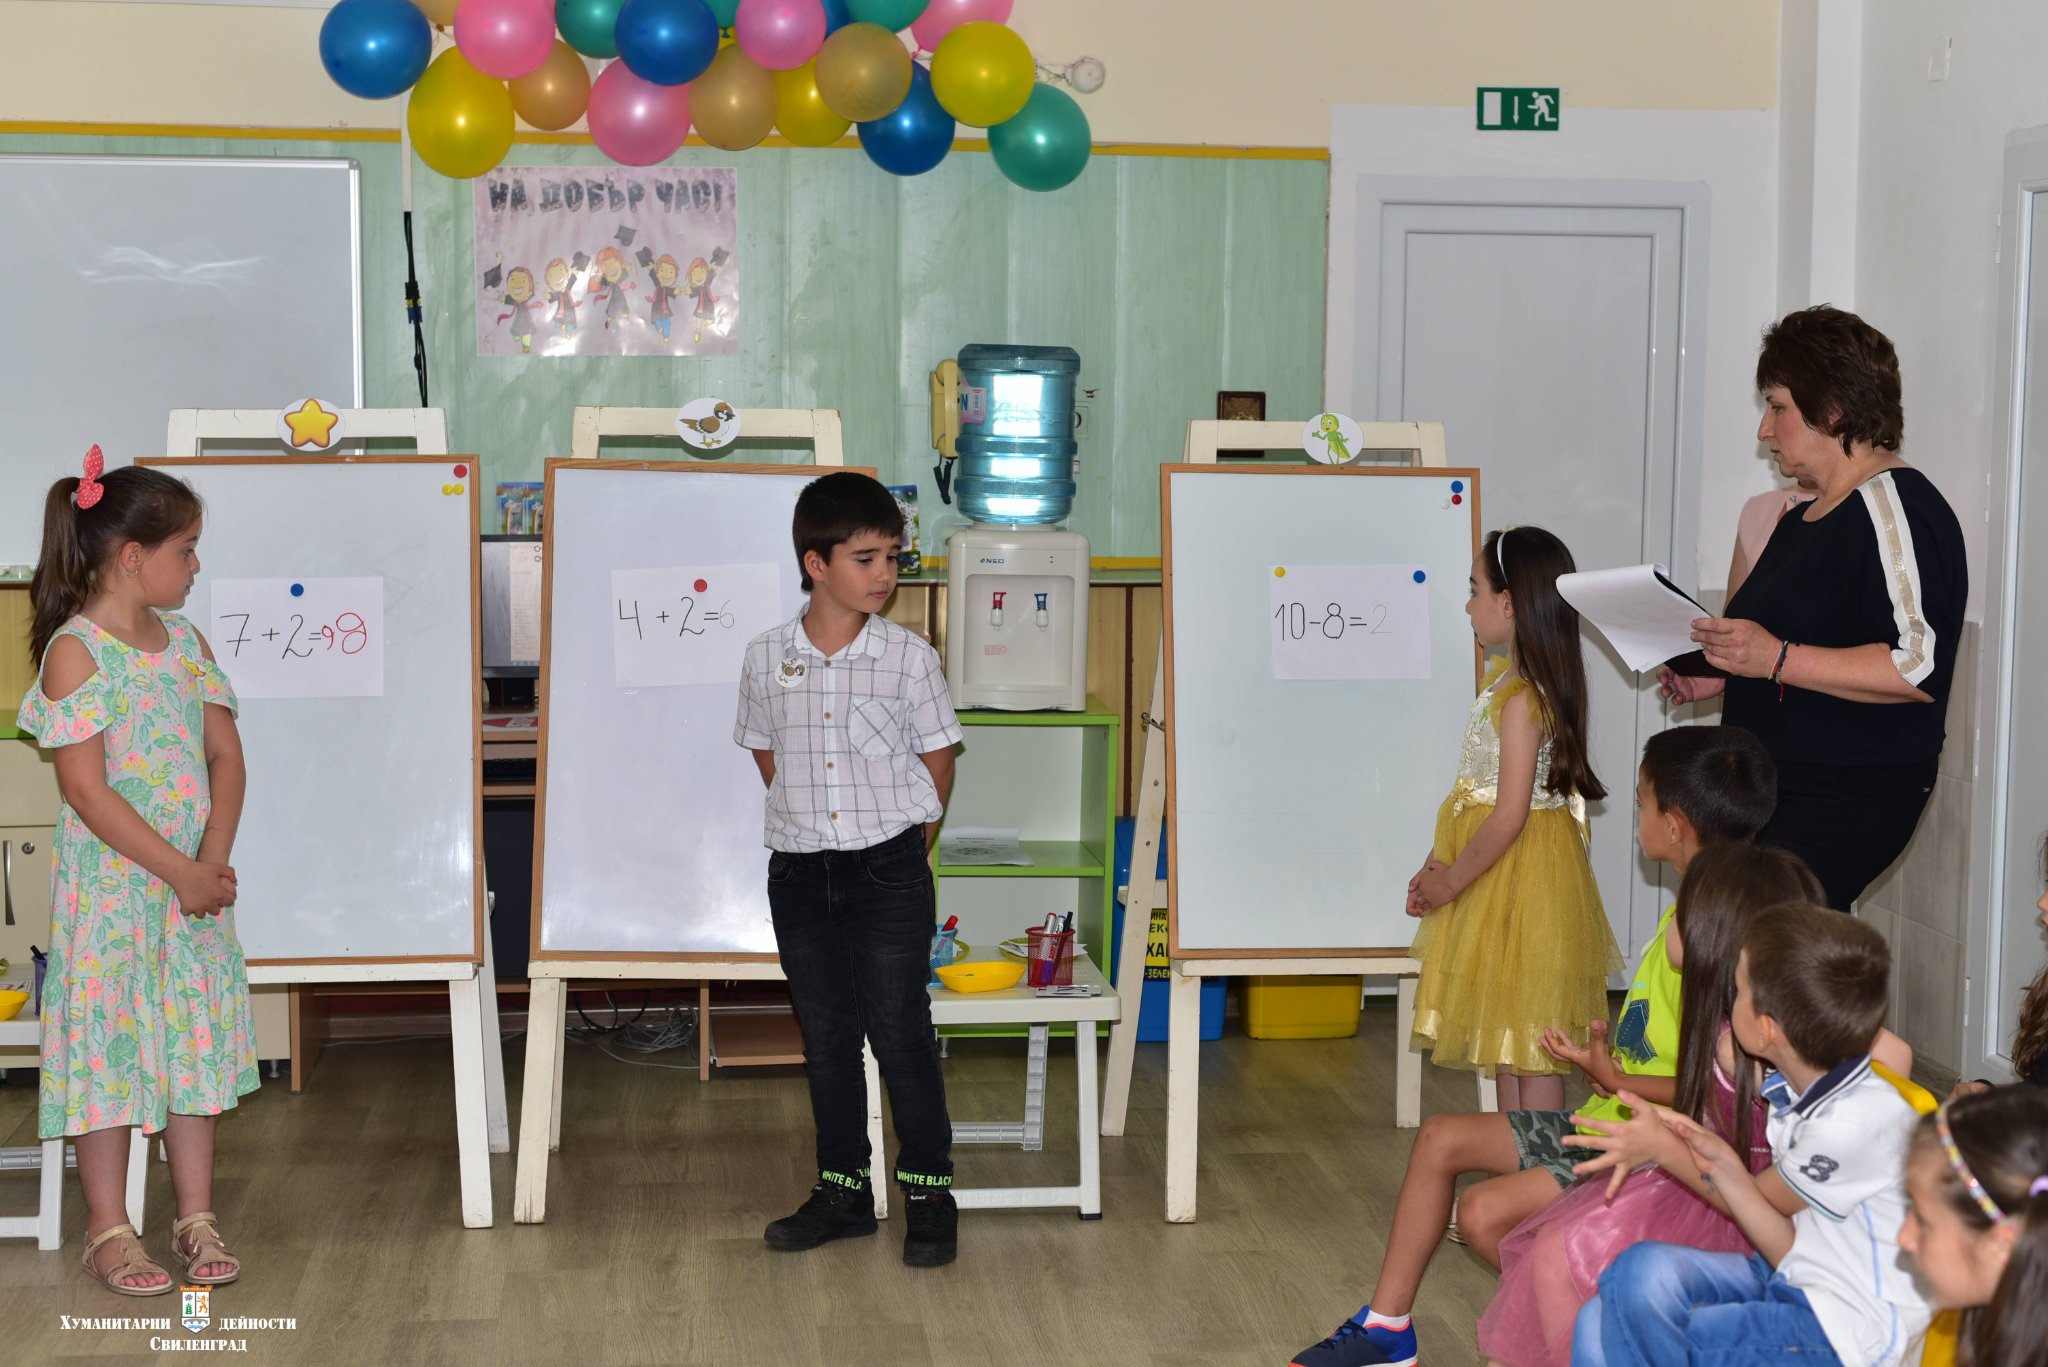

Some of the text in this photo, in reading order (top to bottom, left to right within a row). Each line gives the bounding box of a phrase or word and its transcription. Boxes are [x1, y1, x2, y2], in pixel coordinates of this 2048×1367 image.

[488, 178, 722, 213] НА ДОБЪР ЧАС!
[896, 1169, 953, 1186] WHITE BLACK
